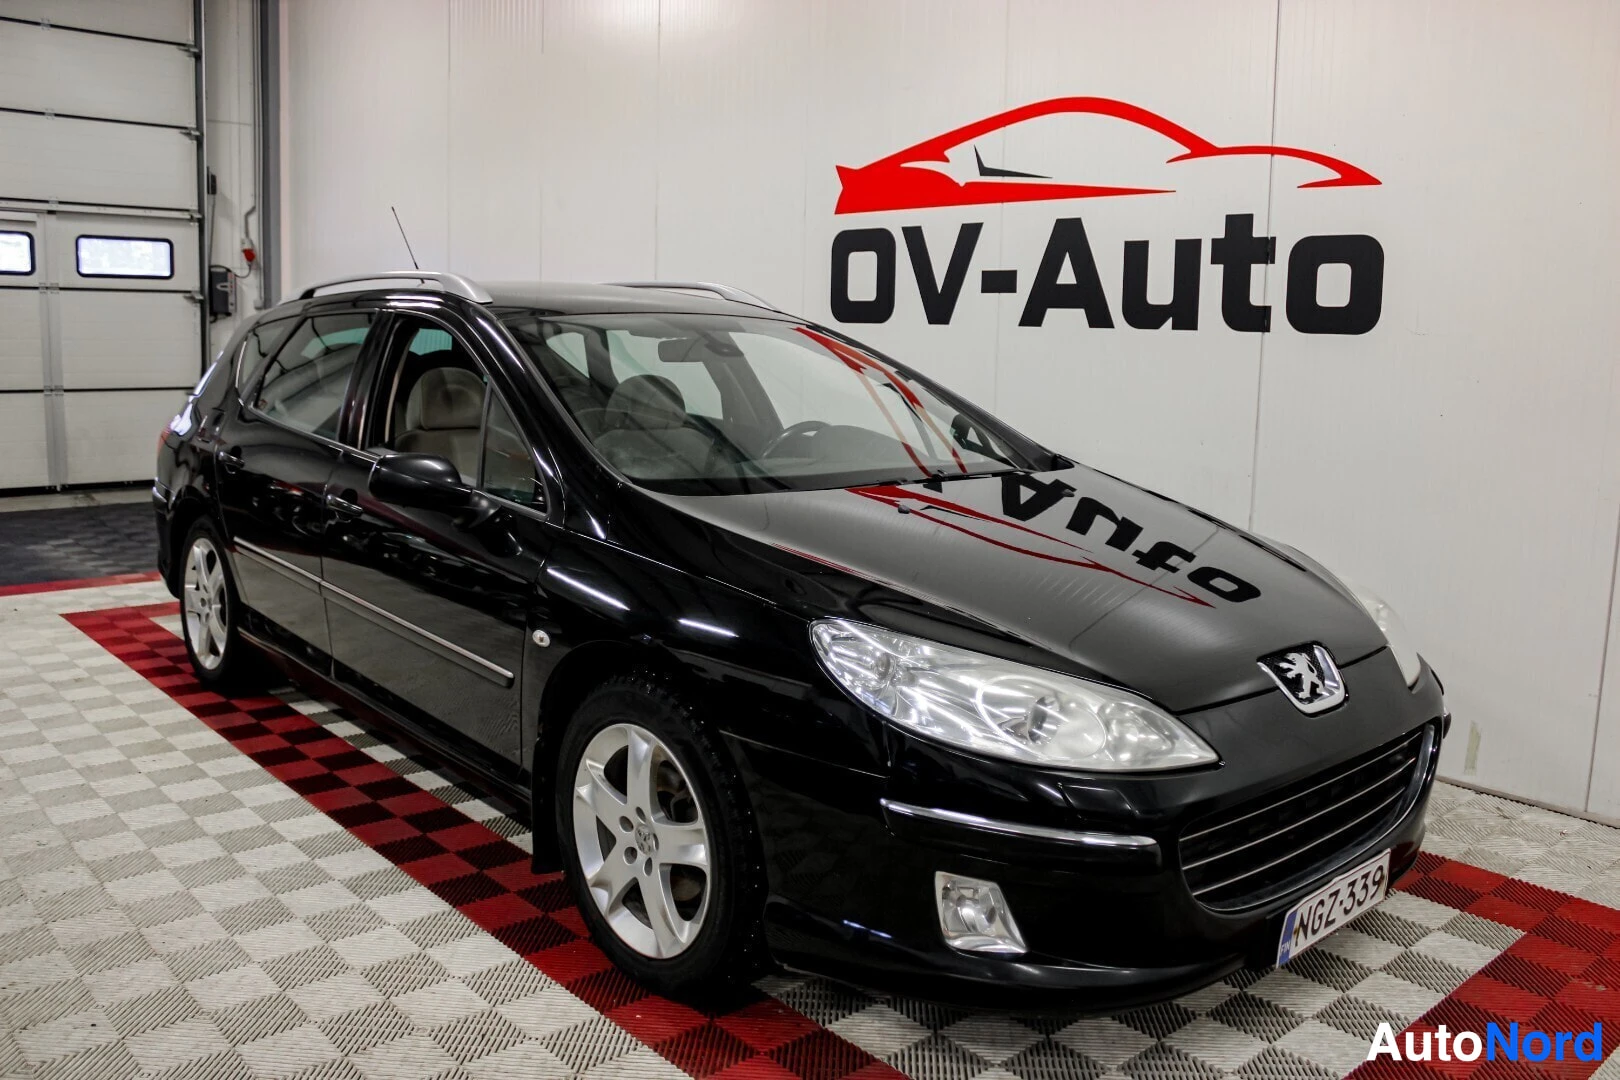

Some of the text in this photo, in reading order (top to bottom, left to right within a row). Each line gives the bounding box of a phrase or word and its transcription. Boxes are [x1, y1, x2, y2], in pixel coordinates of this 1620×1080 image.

[830, 213, 1385, 335] OV-Auto
[1280, 940, 1291, 953] FIN
[1293, 864, 1385, 947] NGZ-339
